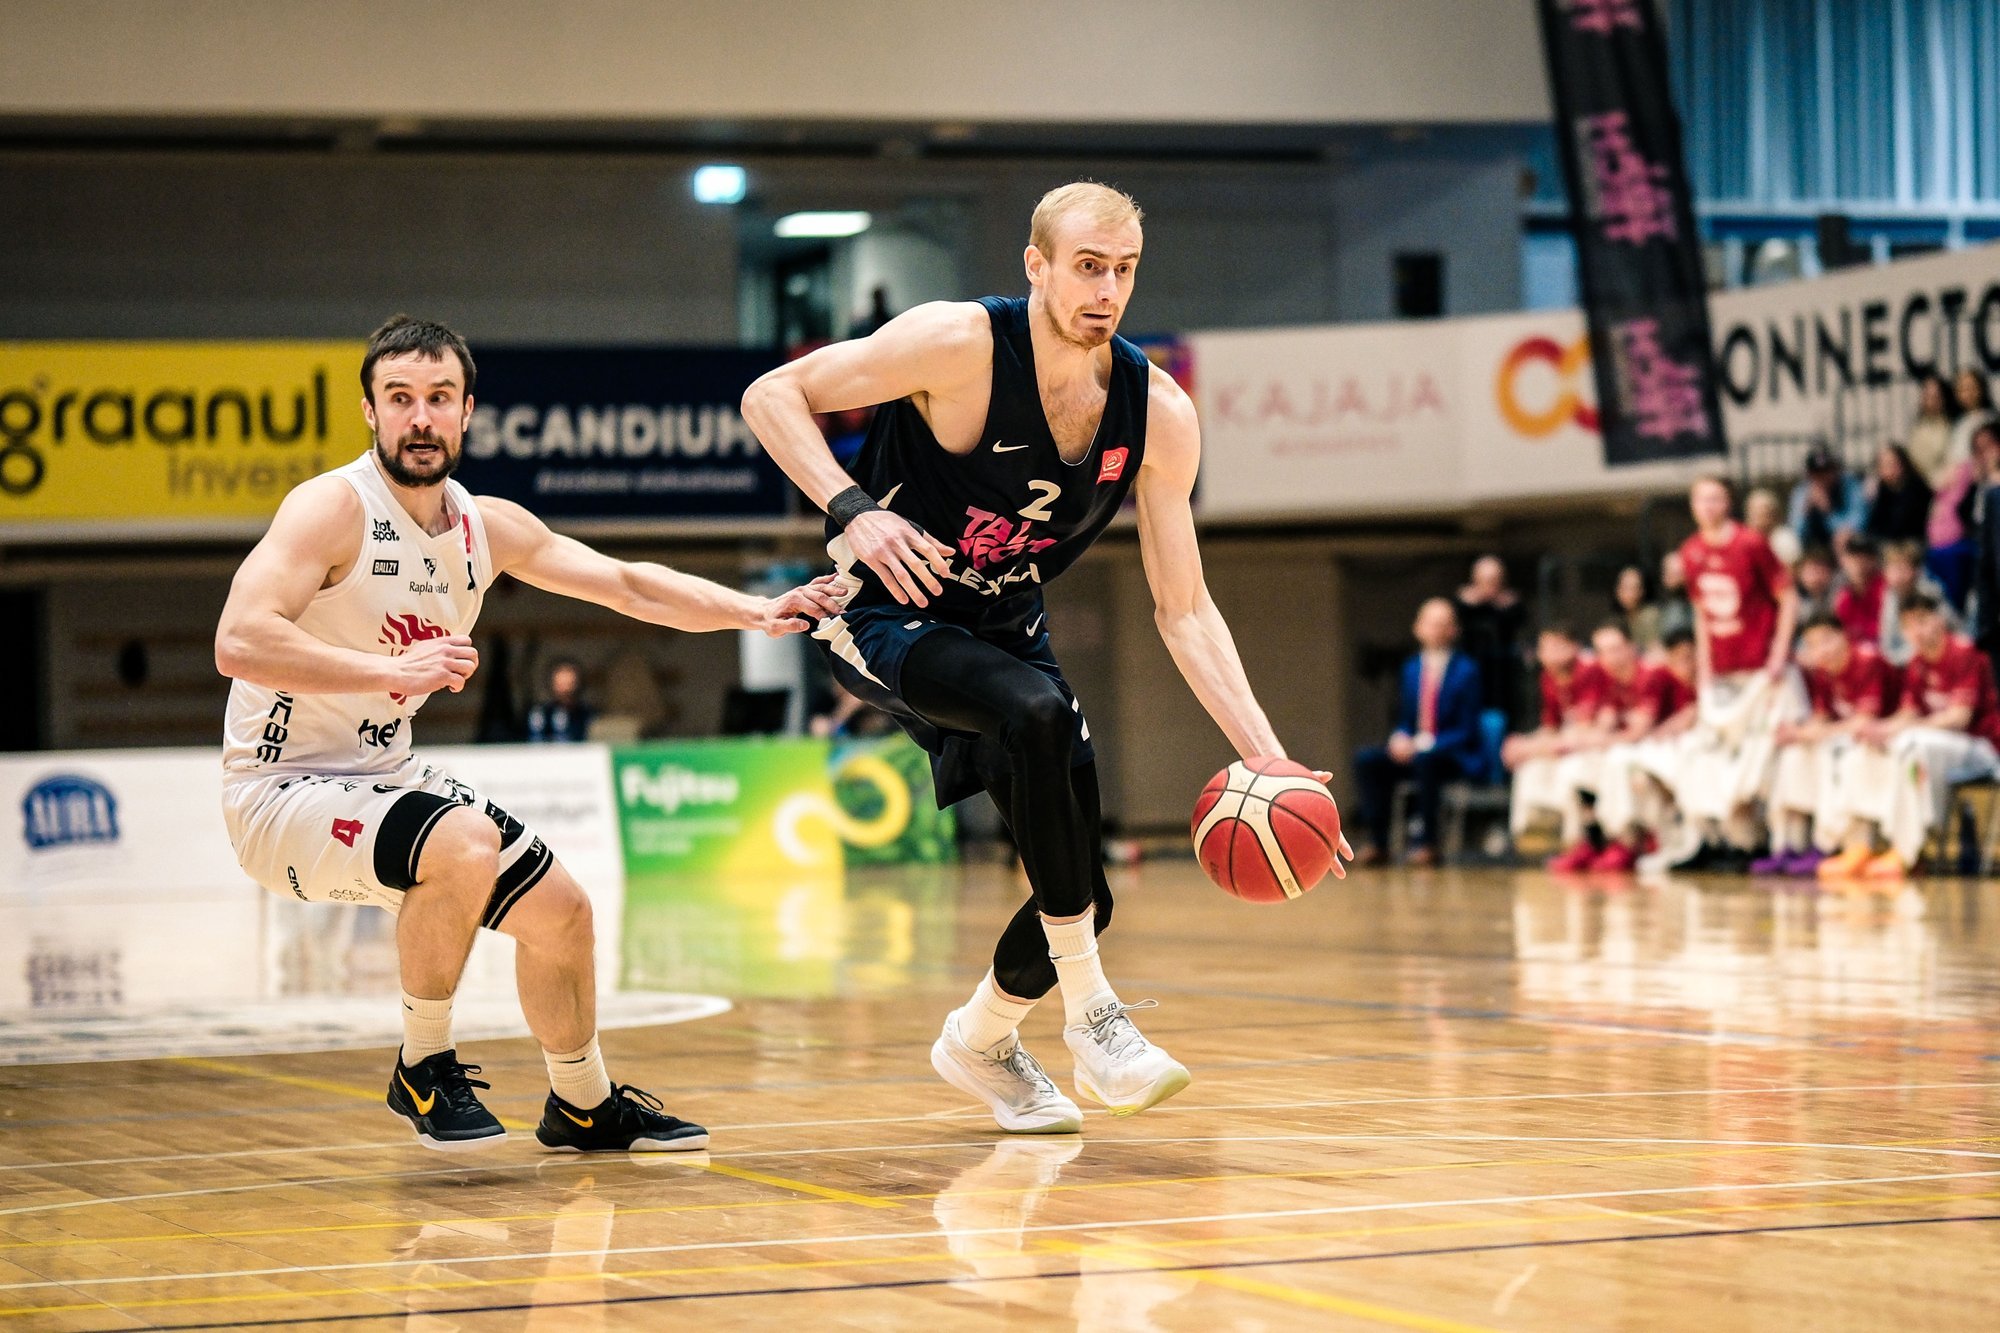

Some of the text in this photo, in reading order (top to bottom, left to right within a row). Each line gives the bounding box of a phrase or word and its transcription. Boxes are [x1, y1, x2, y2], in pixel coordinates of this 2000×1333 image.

[0, 368, 328, 495] graanul
[466, 403, 764, 459] SCANDIUM
[1017, 479, 1062, 522] 2
[373, 561, 398, 574] BALLZY
[409, 581, 433, 595] Rapla
[622, 765, 739, 814] Fujitsu
[331, 818, 365, 848] 4
